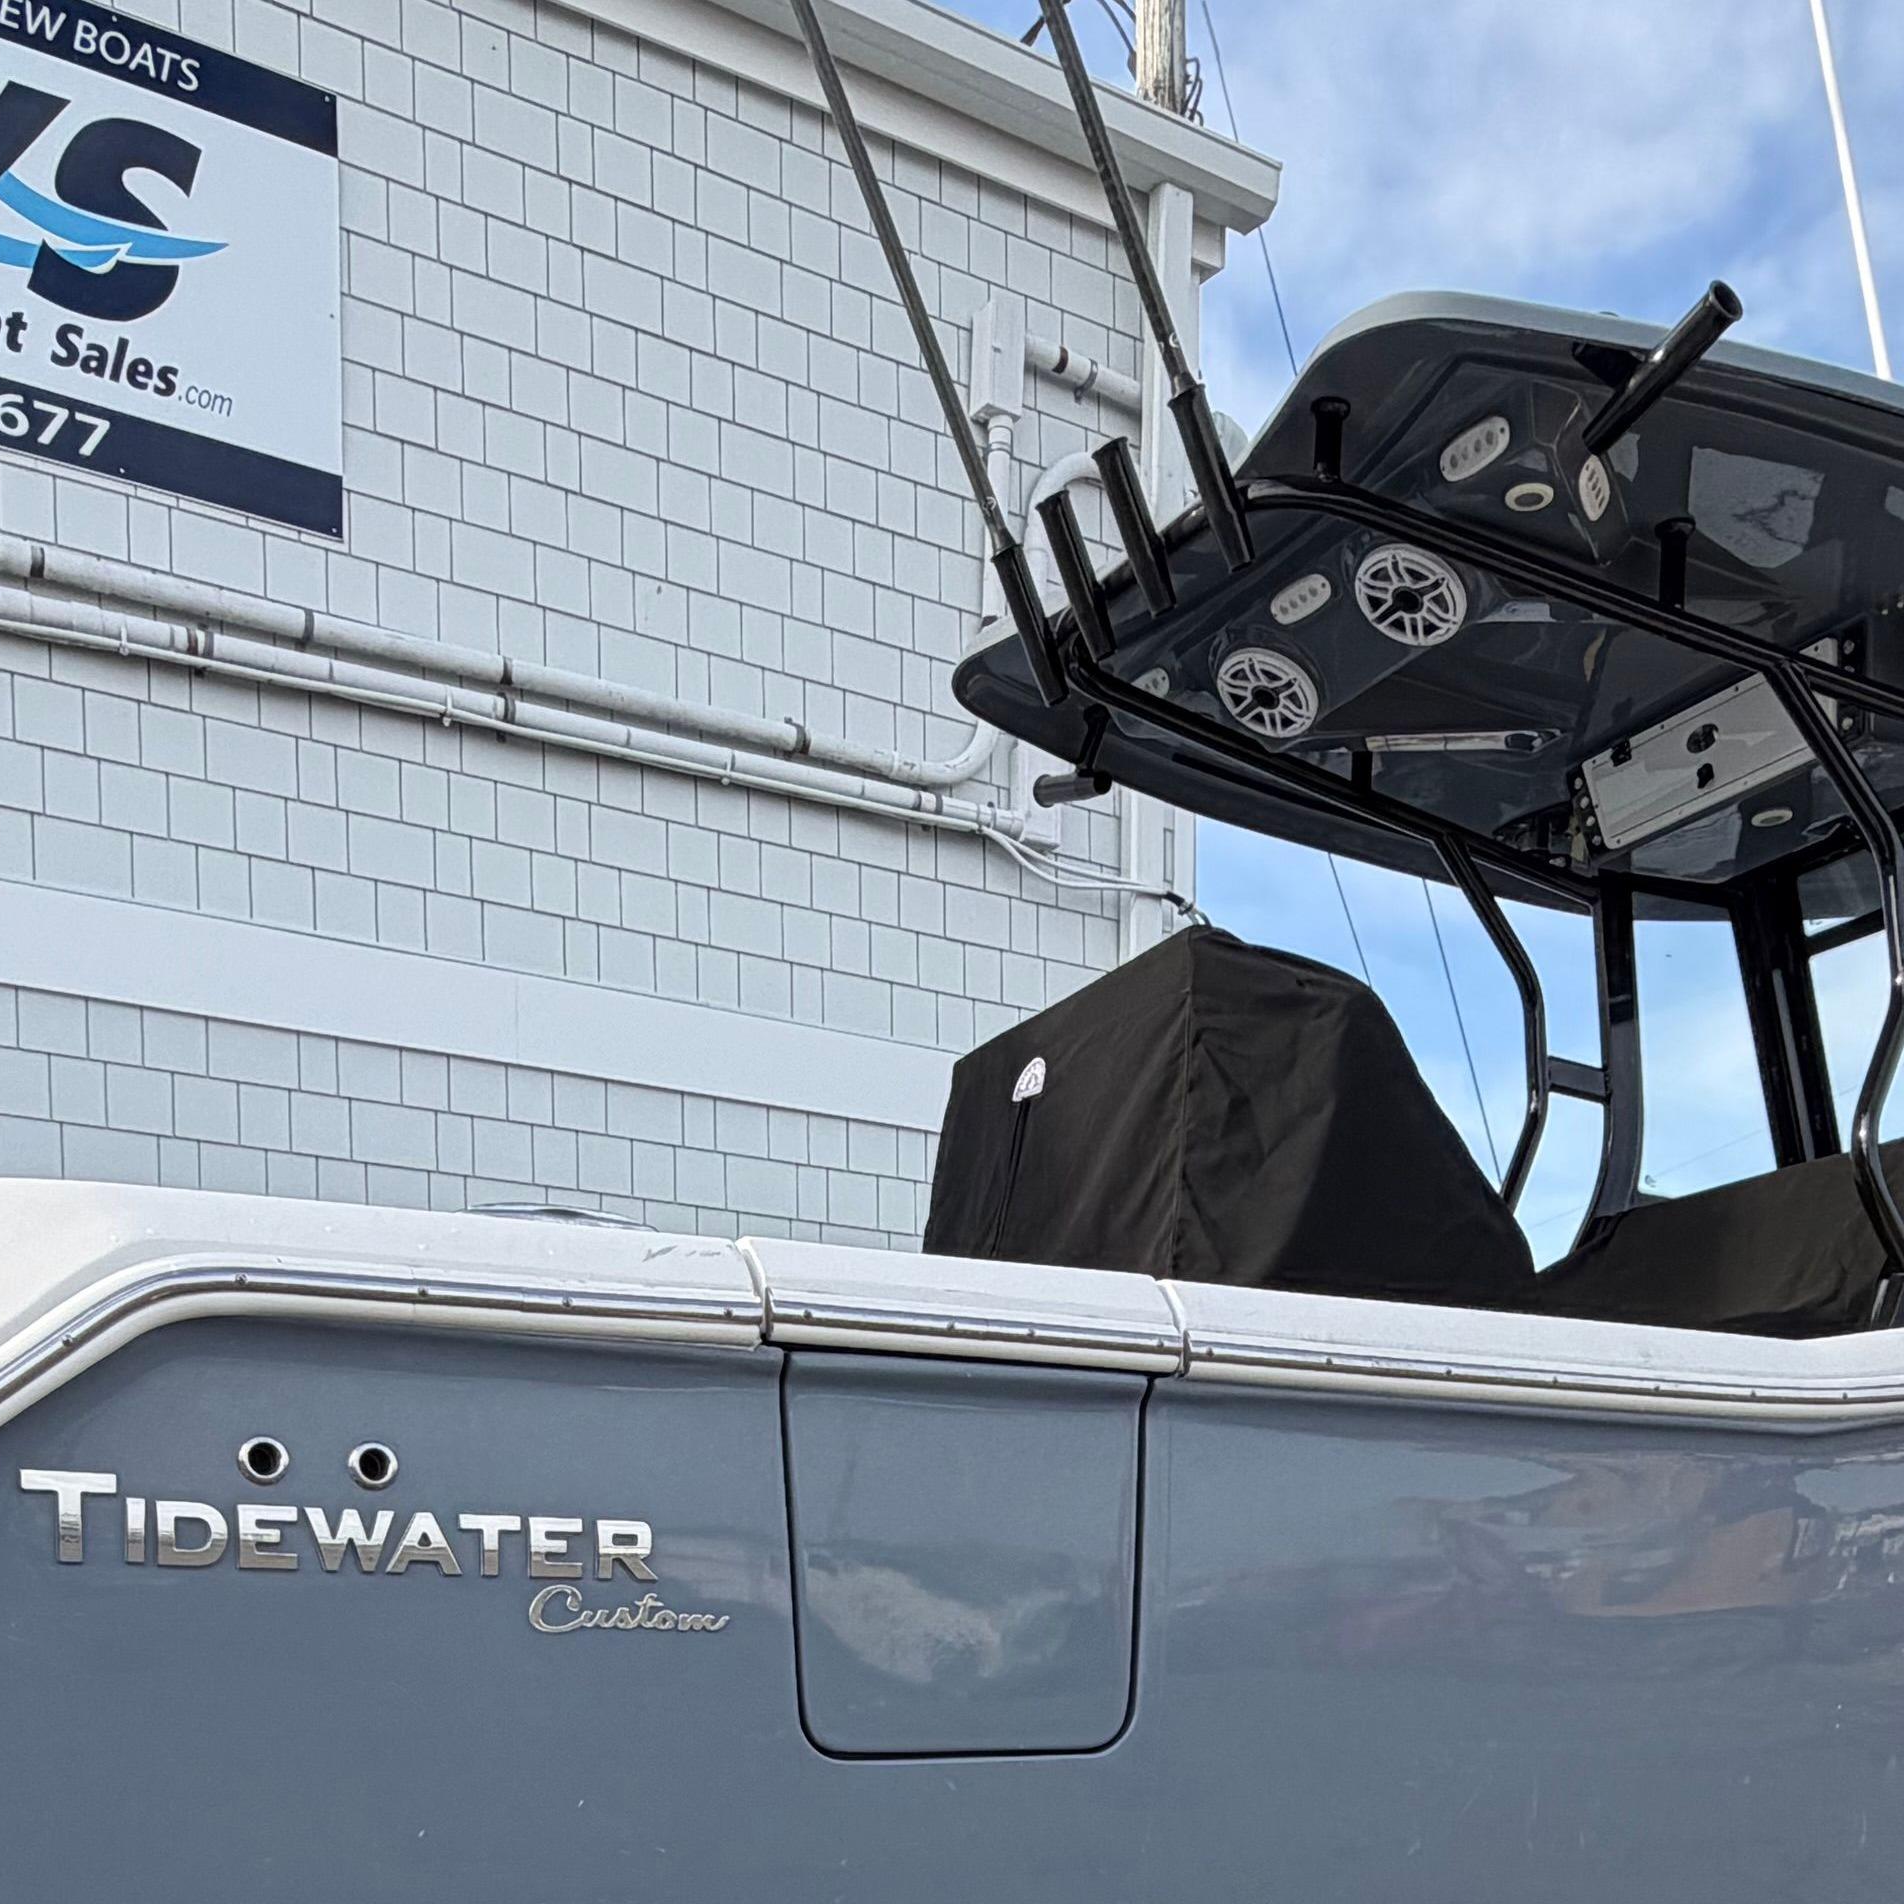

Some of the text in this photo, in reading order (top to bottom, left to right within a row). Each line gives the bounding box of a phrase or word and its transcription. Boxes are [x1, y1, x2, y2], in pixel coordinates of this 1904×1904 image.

[72, 18, 201, 93] BOATS
[19, 1468, 659, 1583] TIDEWATER
[528, 1585, 730, 1635] Custom
